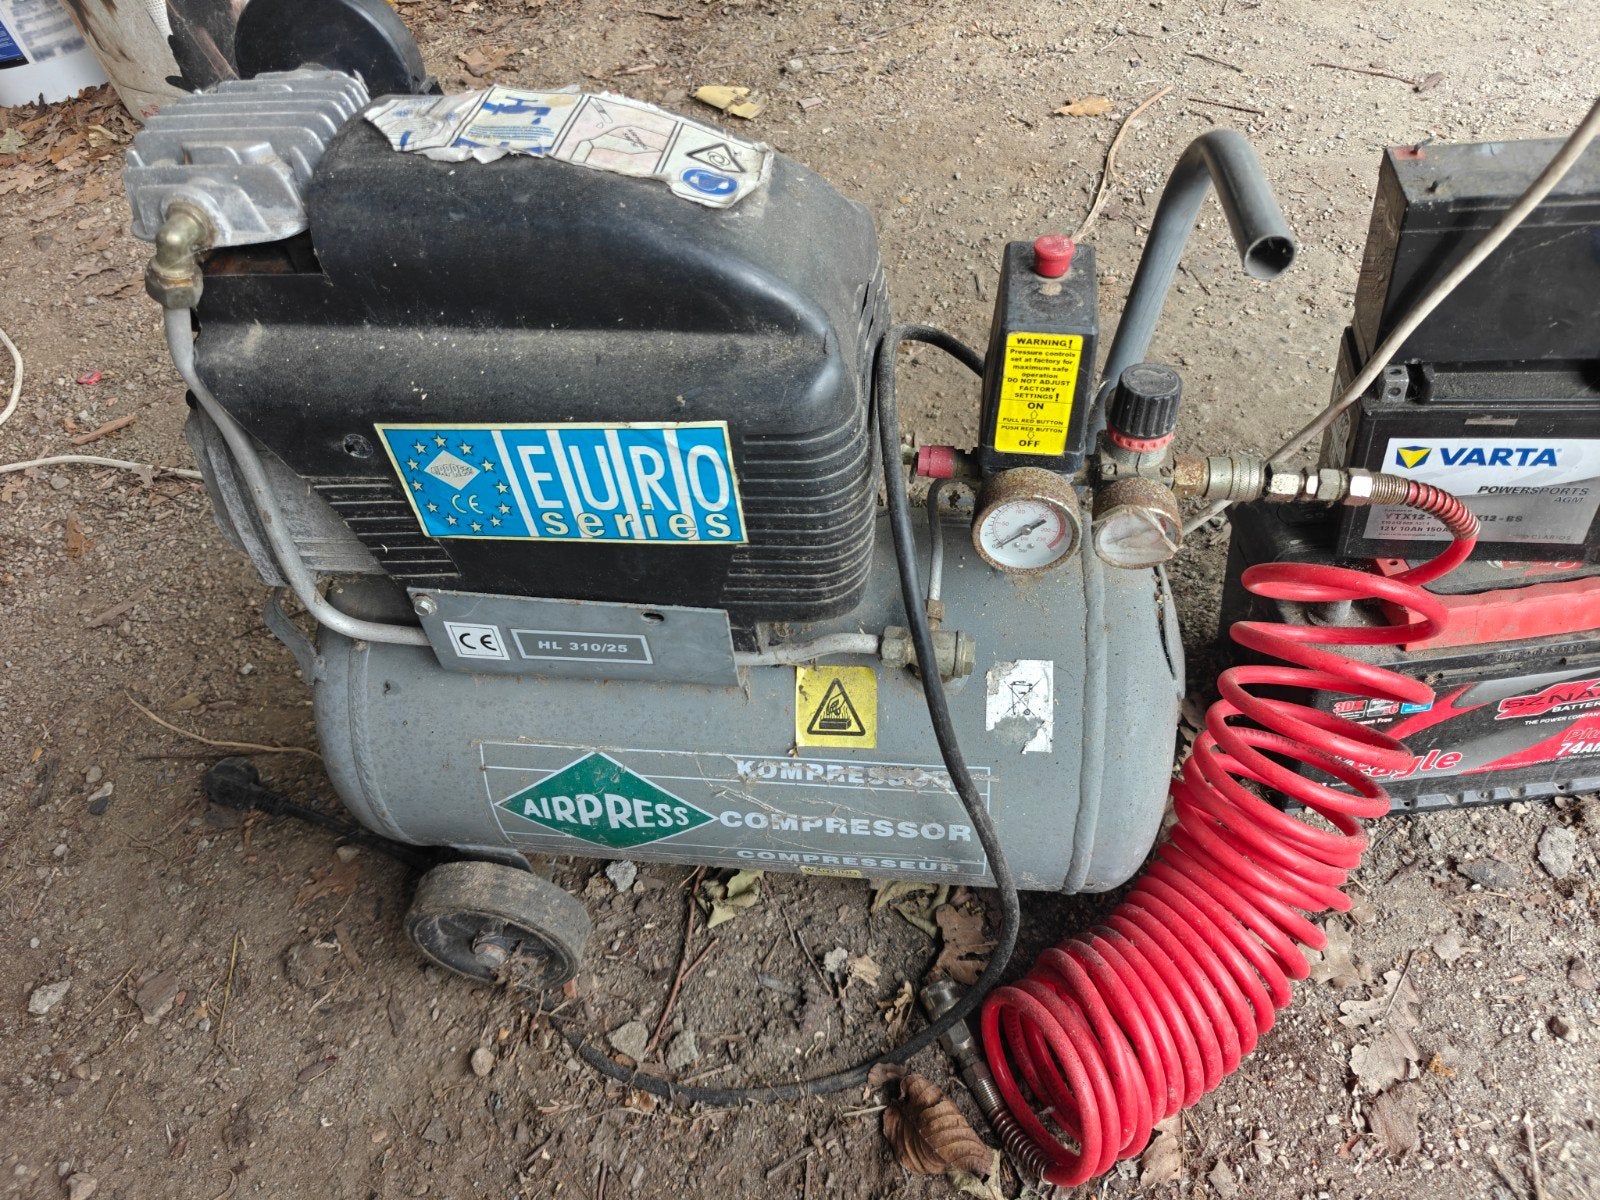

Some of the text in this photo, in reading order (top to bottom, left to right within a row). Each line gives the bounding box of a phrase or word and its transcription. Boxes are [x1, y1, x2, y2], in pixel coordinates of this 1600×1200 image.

[1017, 338, 1072, 348] WARNING!
[1440, 448, 1557, 466] VARTA
[517, 445, 730, 511] EURO
[1478, 486, 1590, 495] POWERSPORTS
[541, 504, 732, 538] series
[538, 640, 628, 653] HL 310/25
[1504, 689, 1600, 709] SZNA
[524, 793, 690, 829] AIRPRESS
[720, 811, 971, 842] COMPRESSOR
[737, 850, 958, 872] COMPRESSEUR
